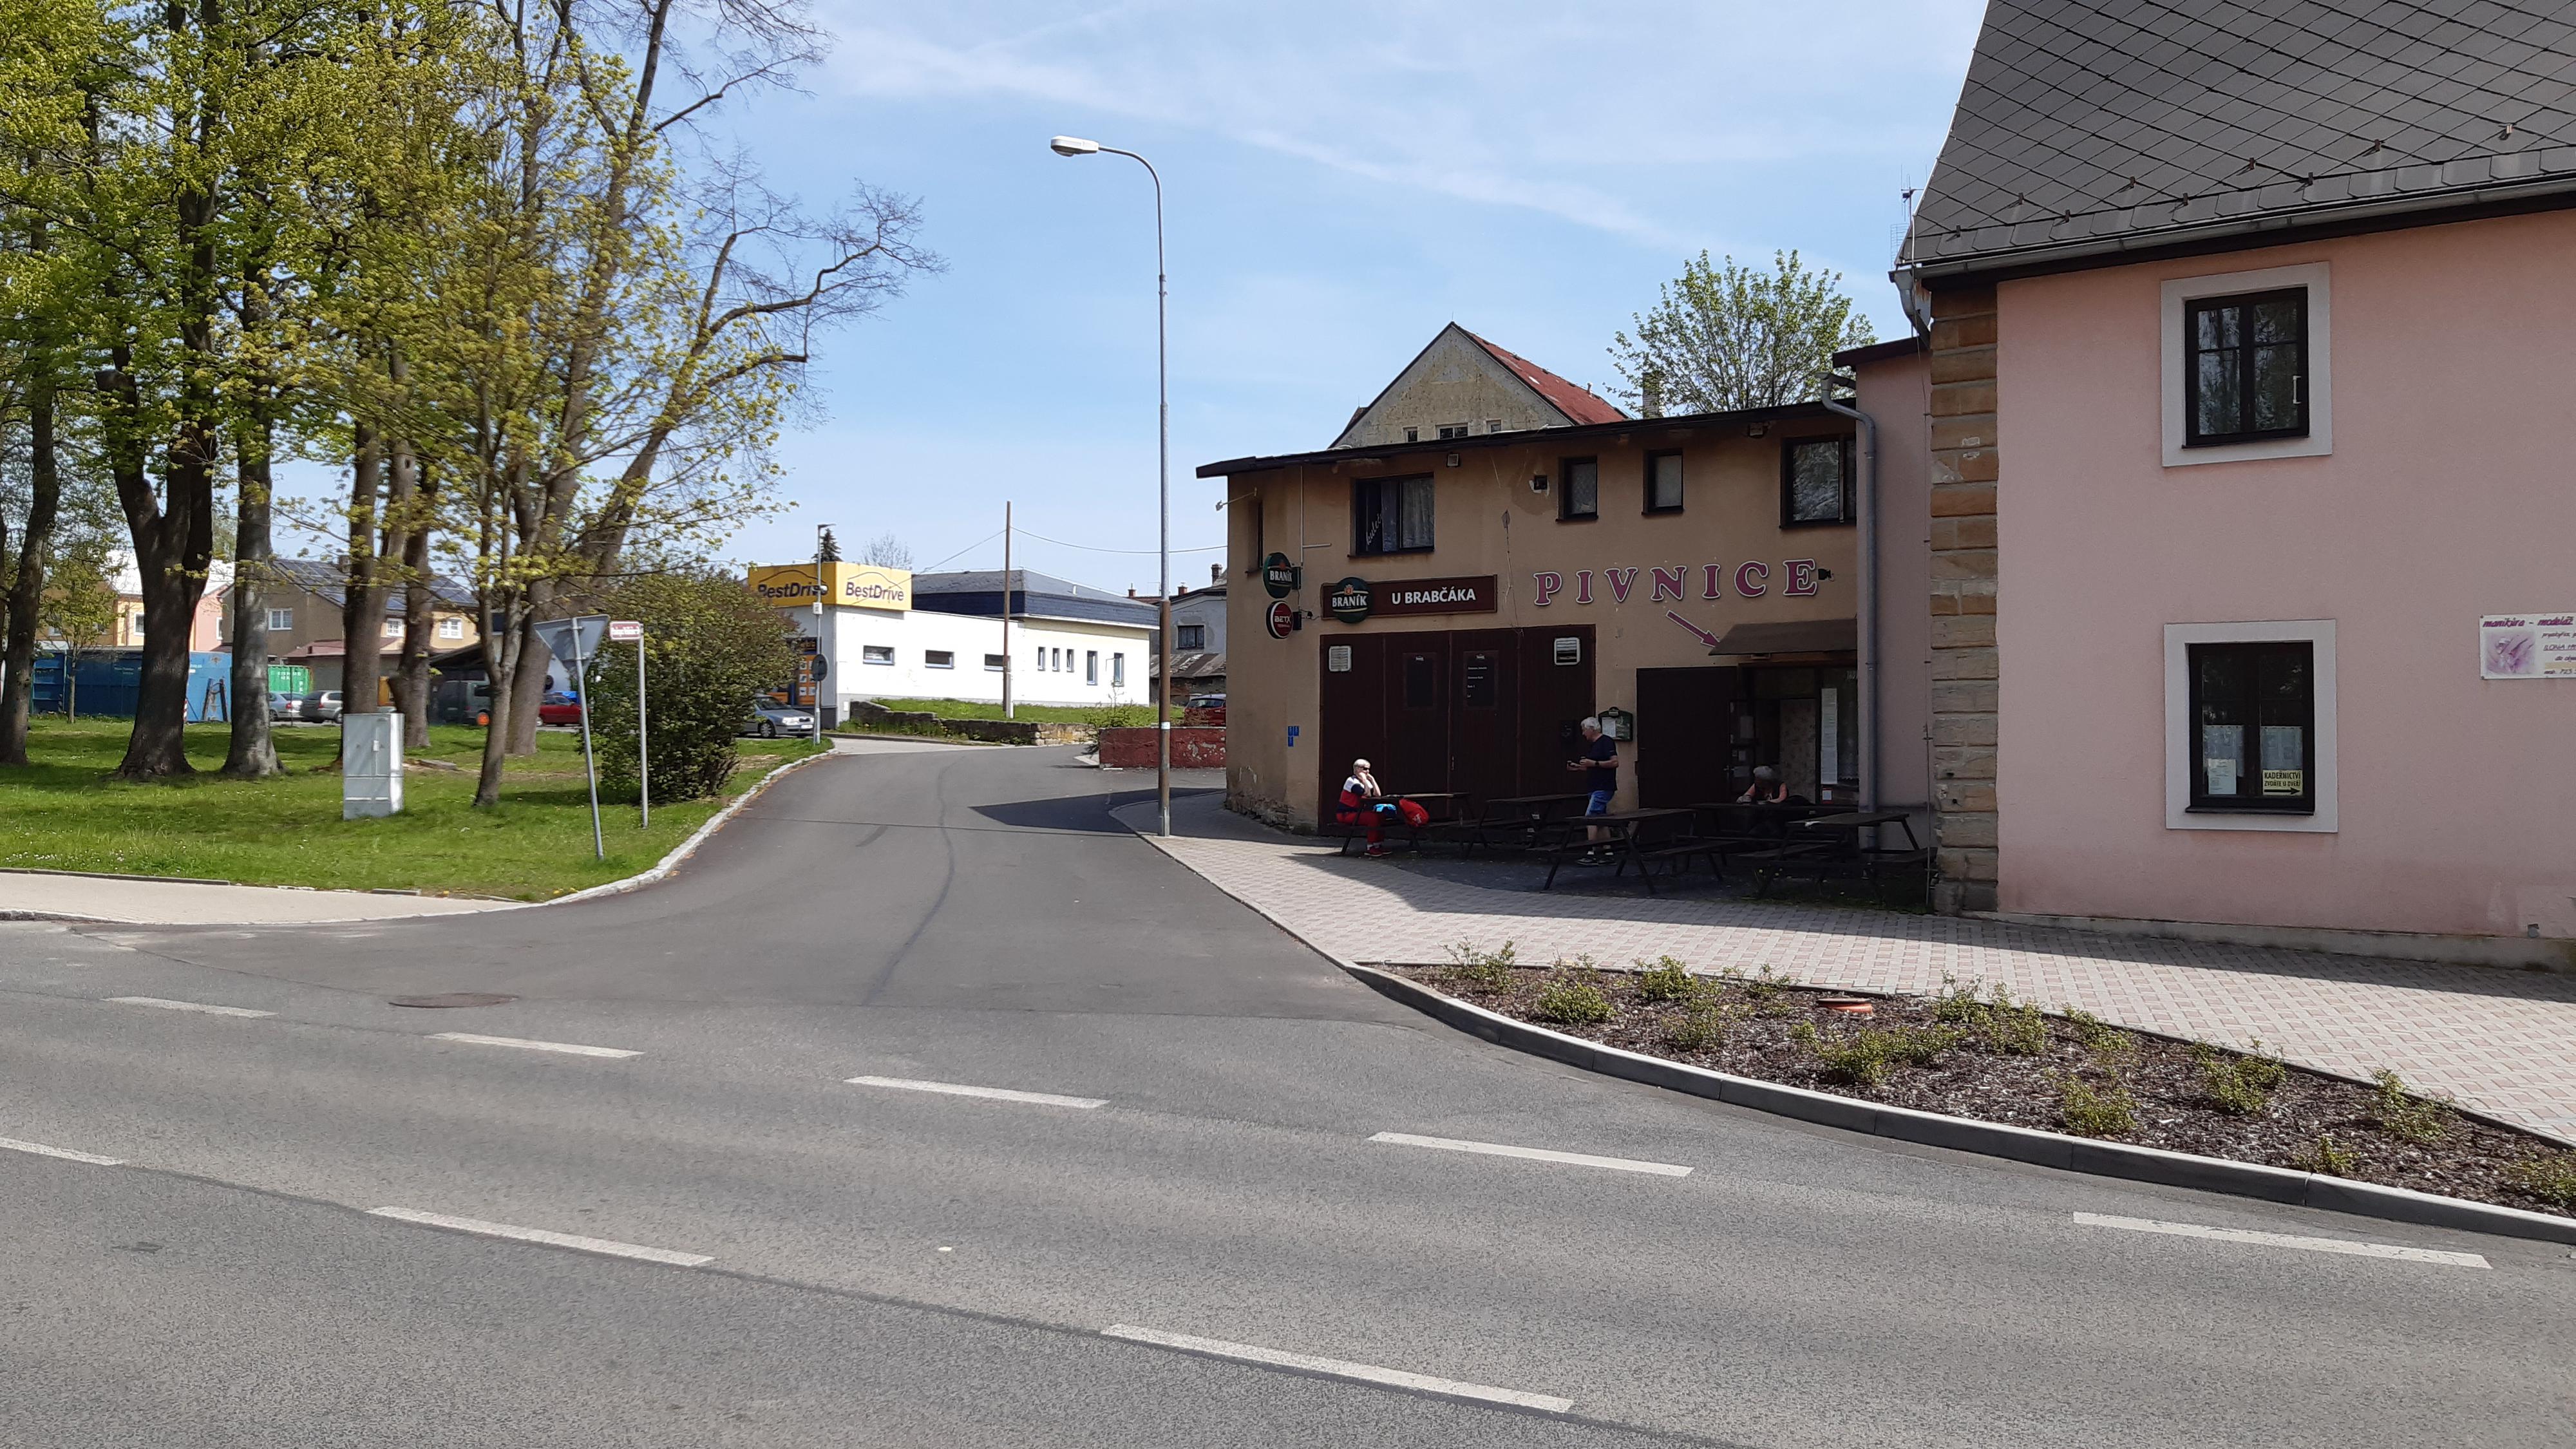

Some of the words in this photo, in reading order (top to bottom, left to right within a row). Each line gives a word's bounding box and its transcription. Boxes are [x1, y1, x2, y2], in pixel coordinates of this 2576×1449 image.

[845, 582, 905, 601] BestDrive
[1533, 558, 1819, 606] PIVNICE
[1332, 594, 1367, 608] BRANÍK
[1391, 592, 1401, 605] U
[1405, 586, 1477, 604] BRABČÁKA
